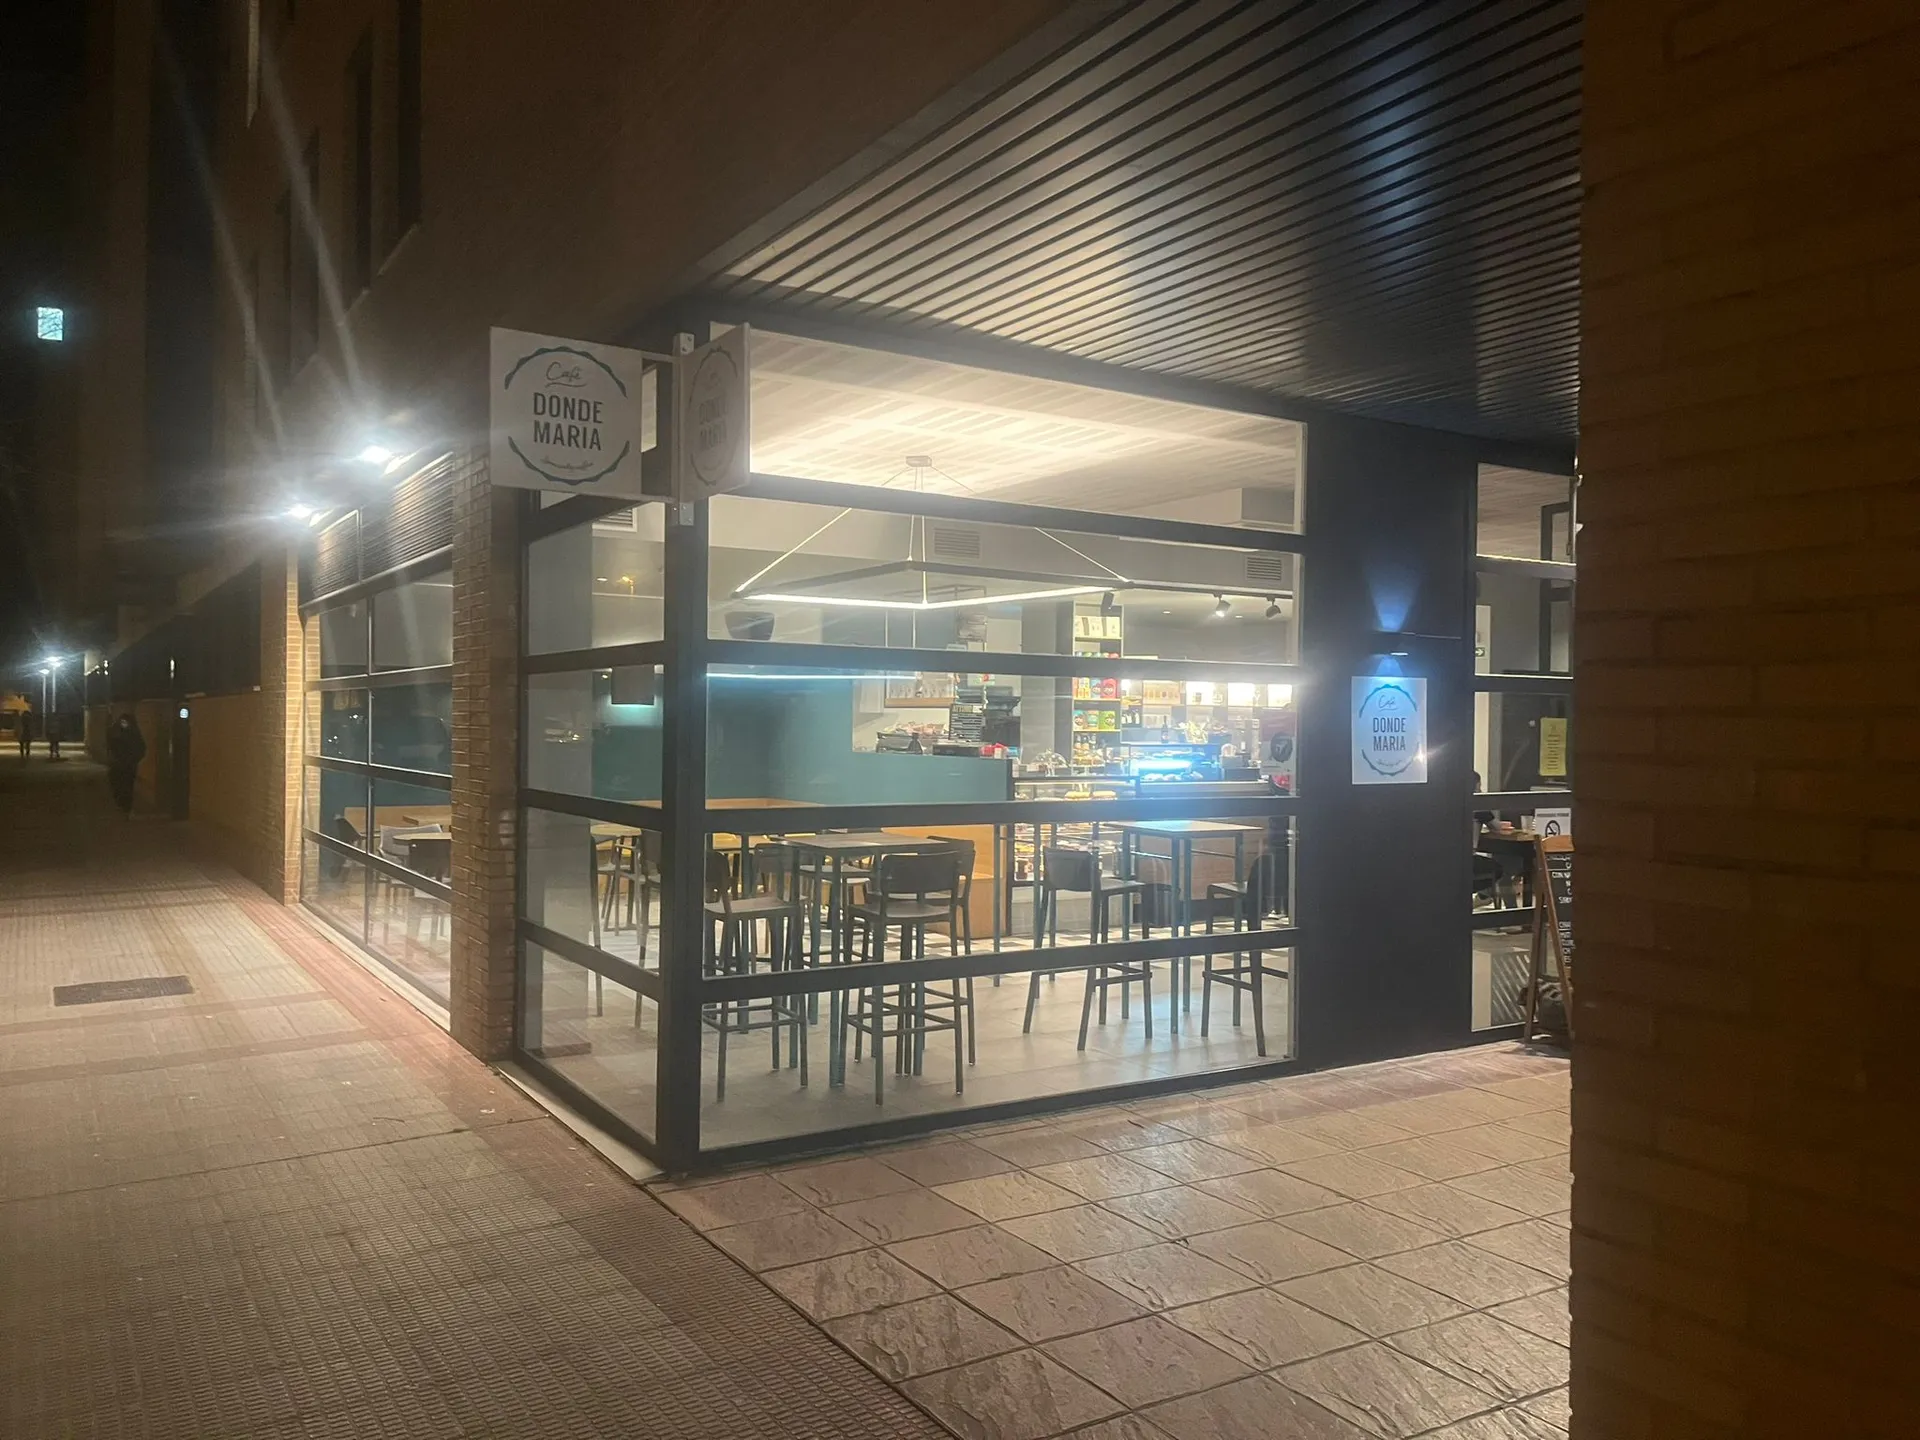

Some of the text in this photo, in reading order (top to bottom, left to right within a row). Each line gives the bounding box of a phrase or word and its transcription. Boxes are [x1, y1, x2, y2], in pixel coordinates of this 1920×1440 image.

[533, 392, 603, 424] DONDE
[533, 420, 602, 451] MARIA
[1373, 717, 1407, 733] DONDE
[1373, 735, 1407, 752] MARIA
